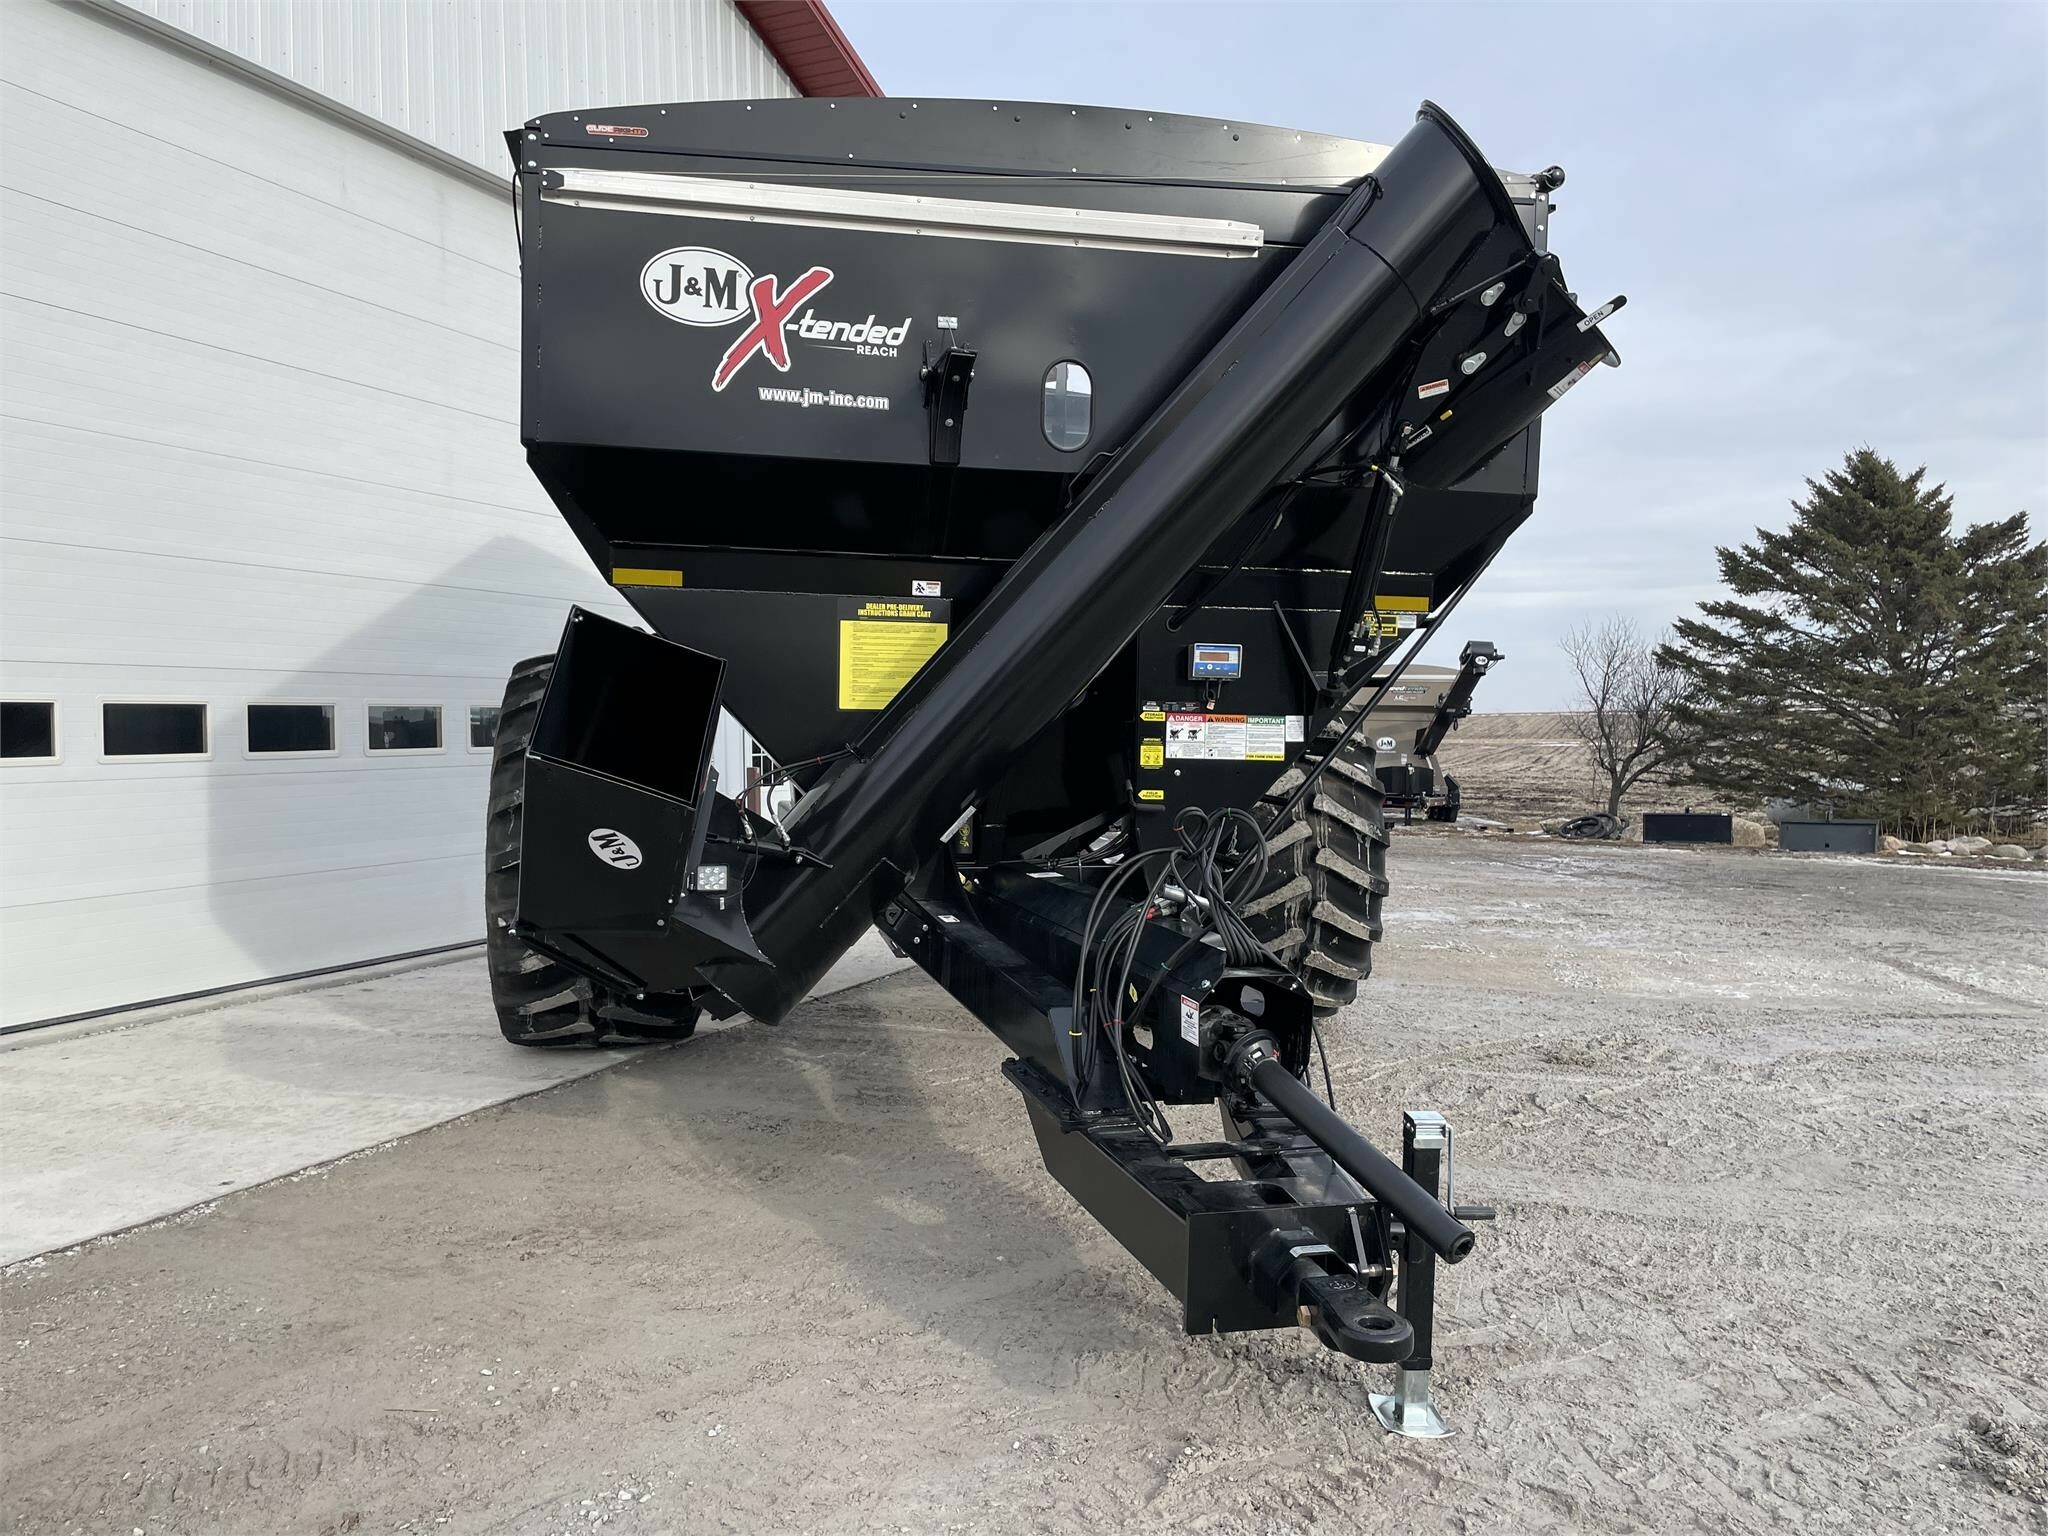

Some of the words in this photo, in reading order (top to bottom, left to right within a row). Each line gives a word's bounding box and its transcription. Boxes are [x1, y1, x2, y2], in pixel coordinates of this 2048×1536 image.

[653, 263, 740, 311] J&M
[1584, 310, 1605, 327] OPEN
[856, 345, 898, 357] REACH
[758, 386, 890, 410] www.jm-inc.com
[857, 609, 899, 617] INSTRUCTIONS
[590, 832, 639, 866] J&M
